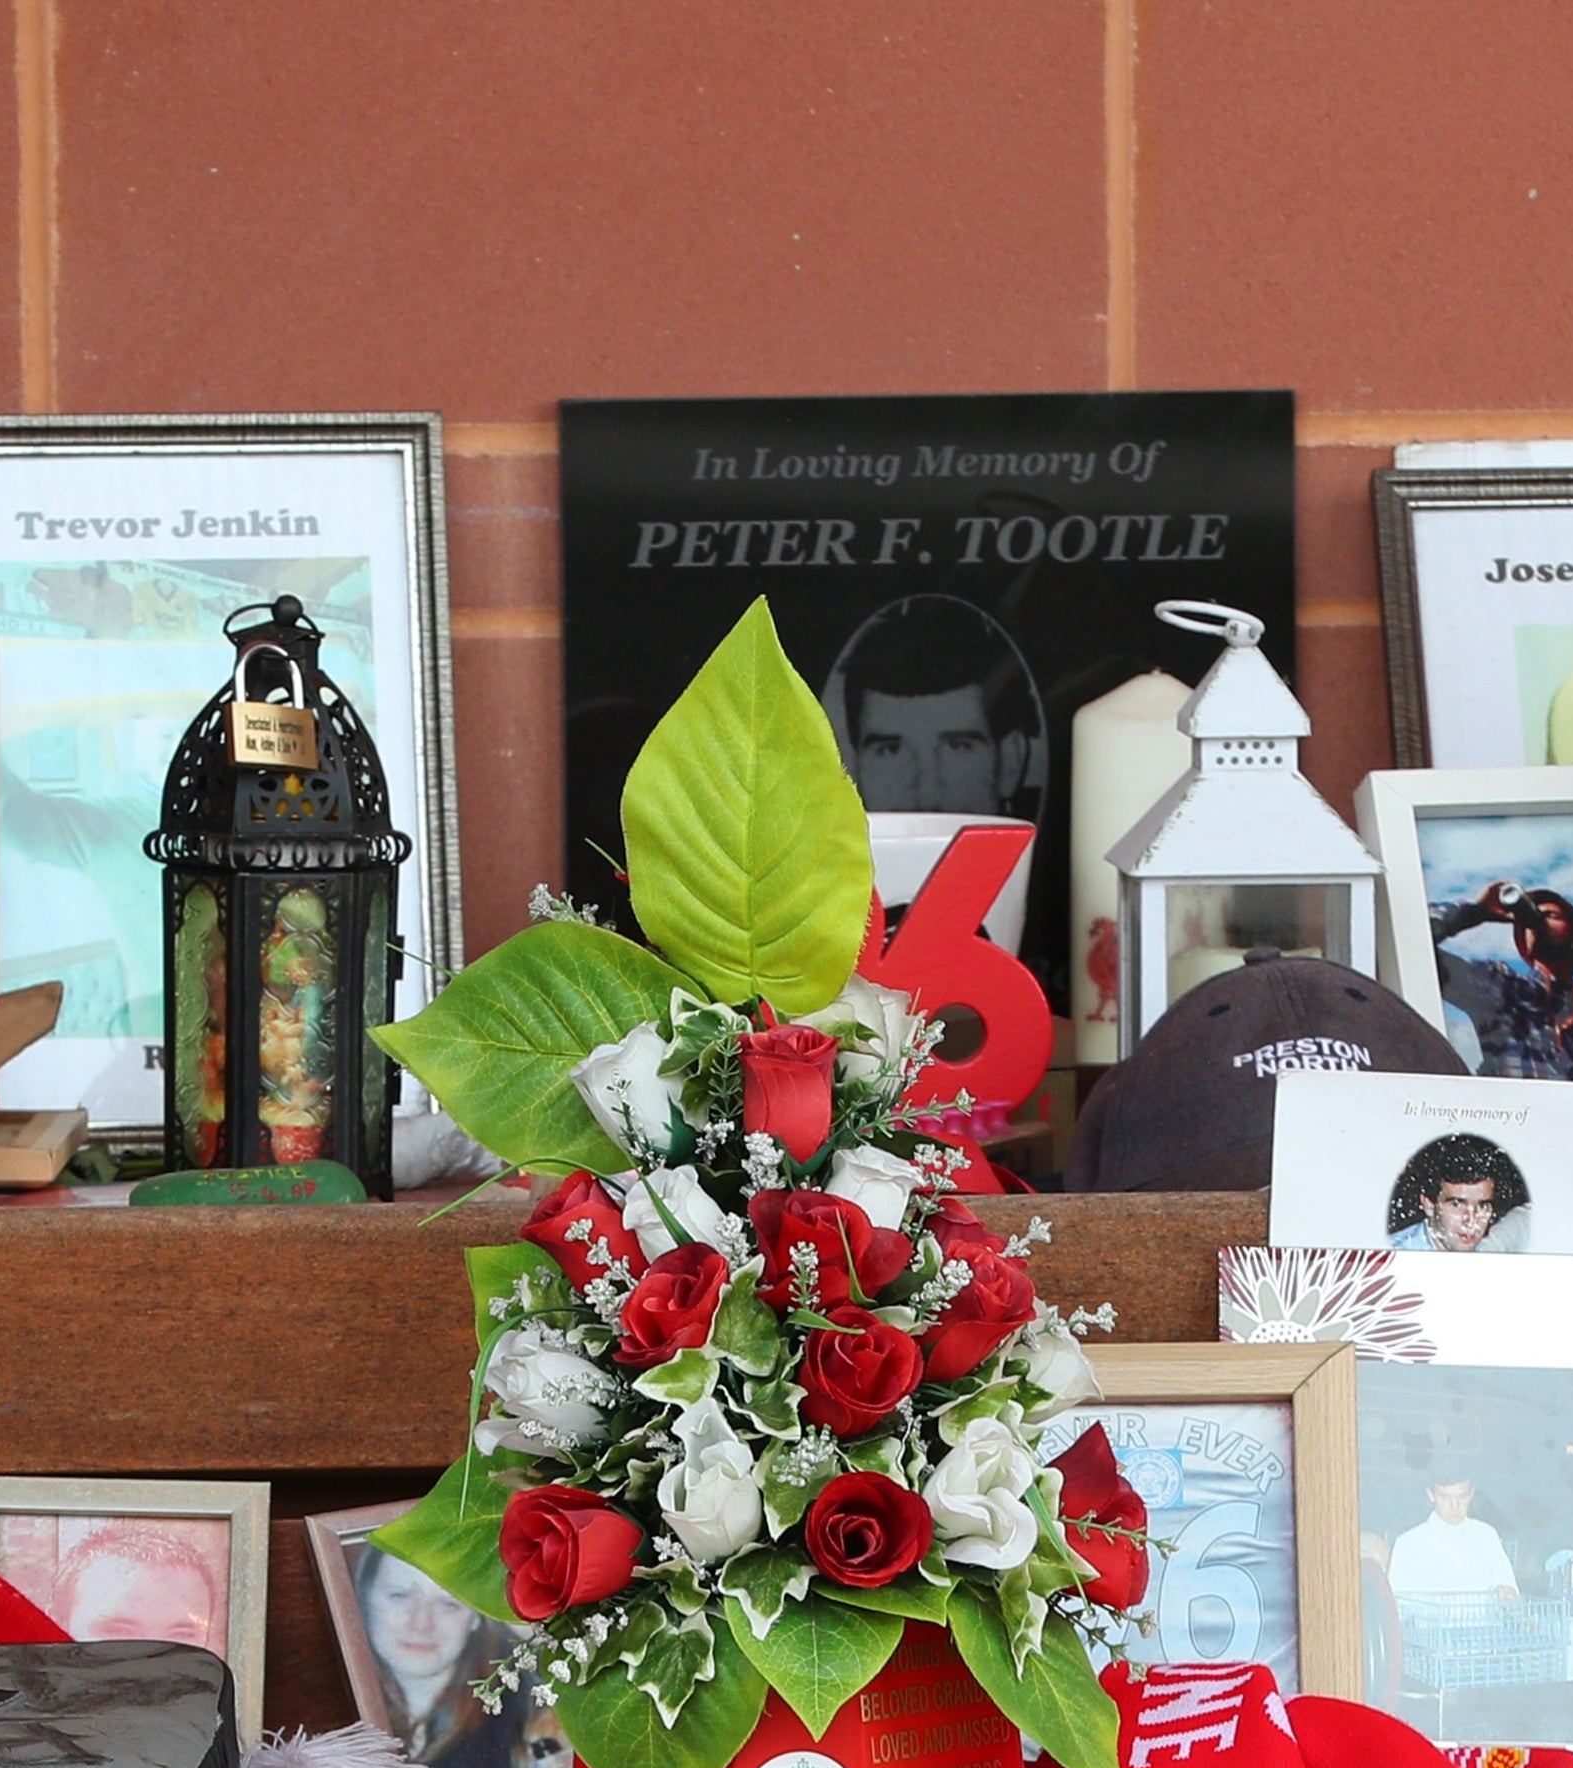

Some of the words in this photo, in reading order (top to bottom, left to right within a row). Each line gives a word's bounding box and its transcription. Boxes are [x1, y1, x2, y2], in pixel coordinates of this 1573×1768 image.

[692, 447, 738, 481] In
[750, 445, 901, 487] Loving
[912, 444, 1096, 483] Memory
[1108, 440, 1166, 477] Of
[15, 510, 162, 541] Trevor
[172, 508, 321, 540] Jenkin
[628, 519, 857, 568] PETER
[872, 518, 932, 565] F.
[954, 514, 1229, 564] TOOTLE
[1233, 1036, 1371, 1068] PRESTON
[1256, 1055, 1359, 1078] NORTH
[1404, 1101, 1418, 1116] In
[1419, 1101, 1460, 1123] loving
[1461, 1106, 1512, 1125] memory
[1514, 1105, 1531, 1123] of
[1177, 1416, 1286, 1495] EVER
[860, 1685, 928, 1723] BELOVED
[933, 1678, 987, 1710] GRAND
[871, 1730, 919, 1764] LOVED
[924, 1725, 953, 1755] AND
[956, 1715, 1011, 1749] MISSED
